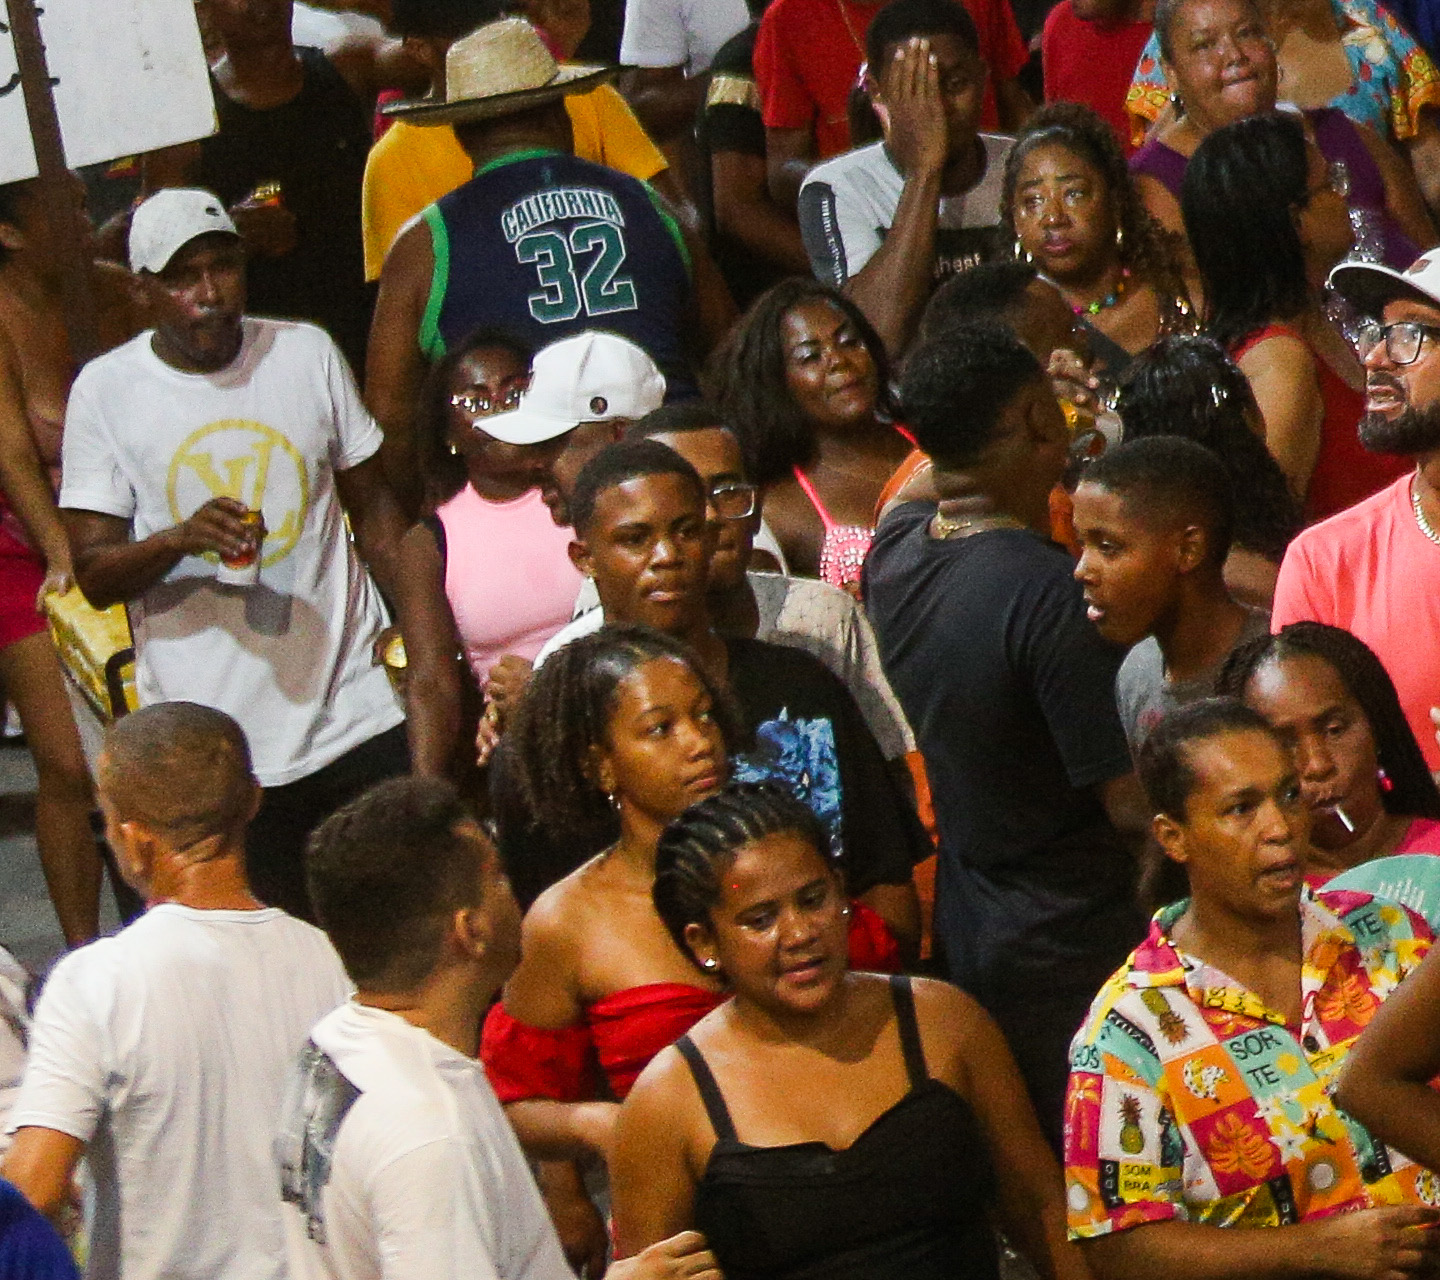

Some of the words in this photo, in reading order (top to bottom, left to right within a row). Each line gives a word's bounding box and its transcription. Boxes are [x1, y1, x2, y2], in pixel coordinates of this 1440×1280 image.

[501, 188, 626, 244] CALIFORNIA
[515, 219, 639, 324] 32
[1350, 912, 1382, 939] TE
[1229, 1029, 1283, 1063] SOR
[1247, 1062, 1281, 1089] TE
